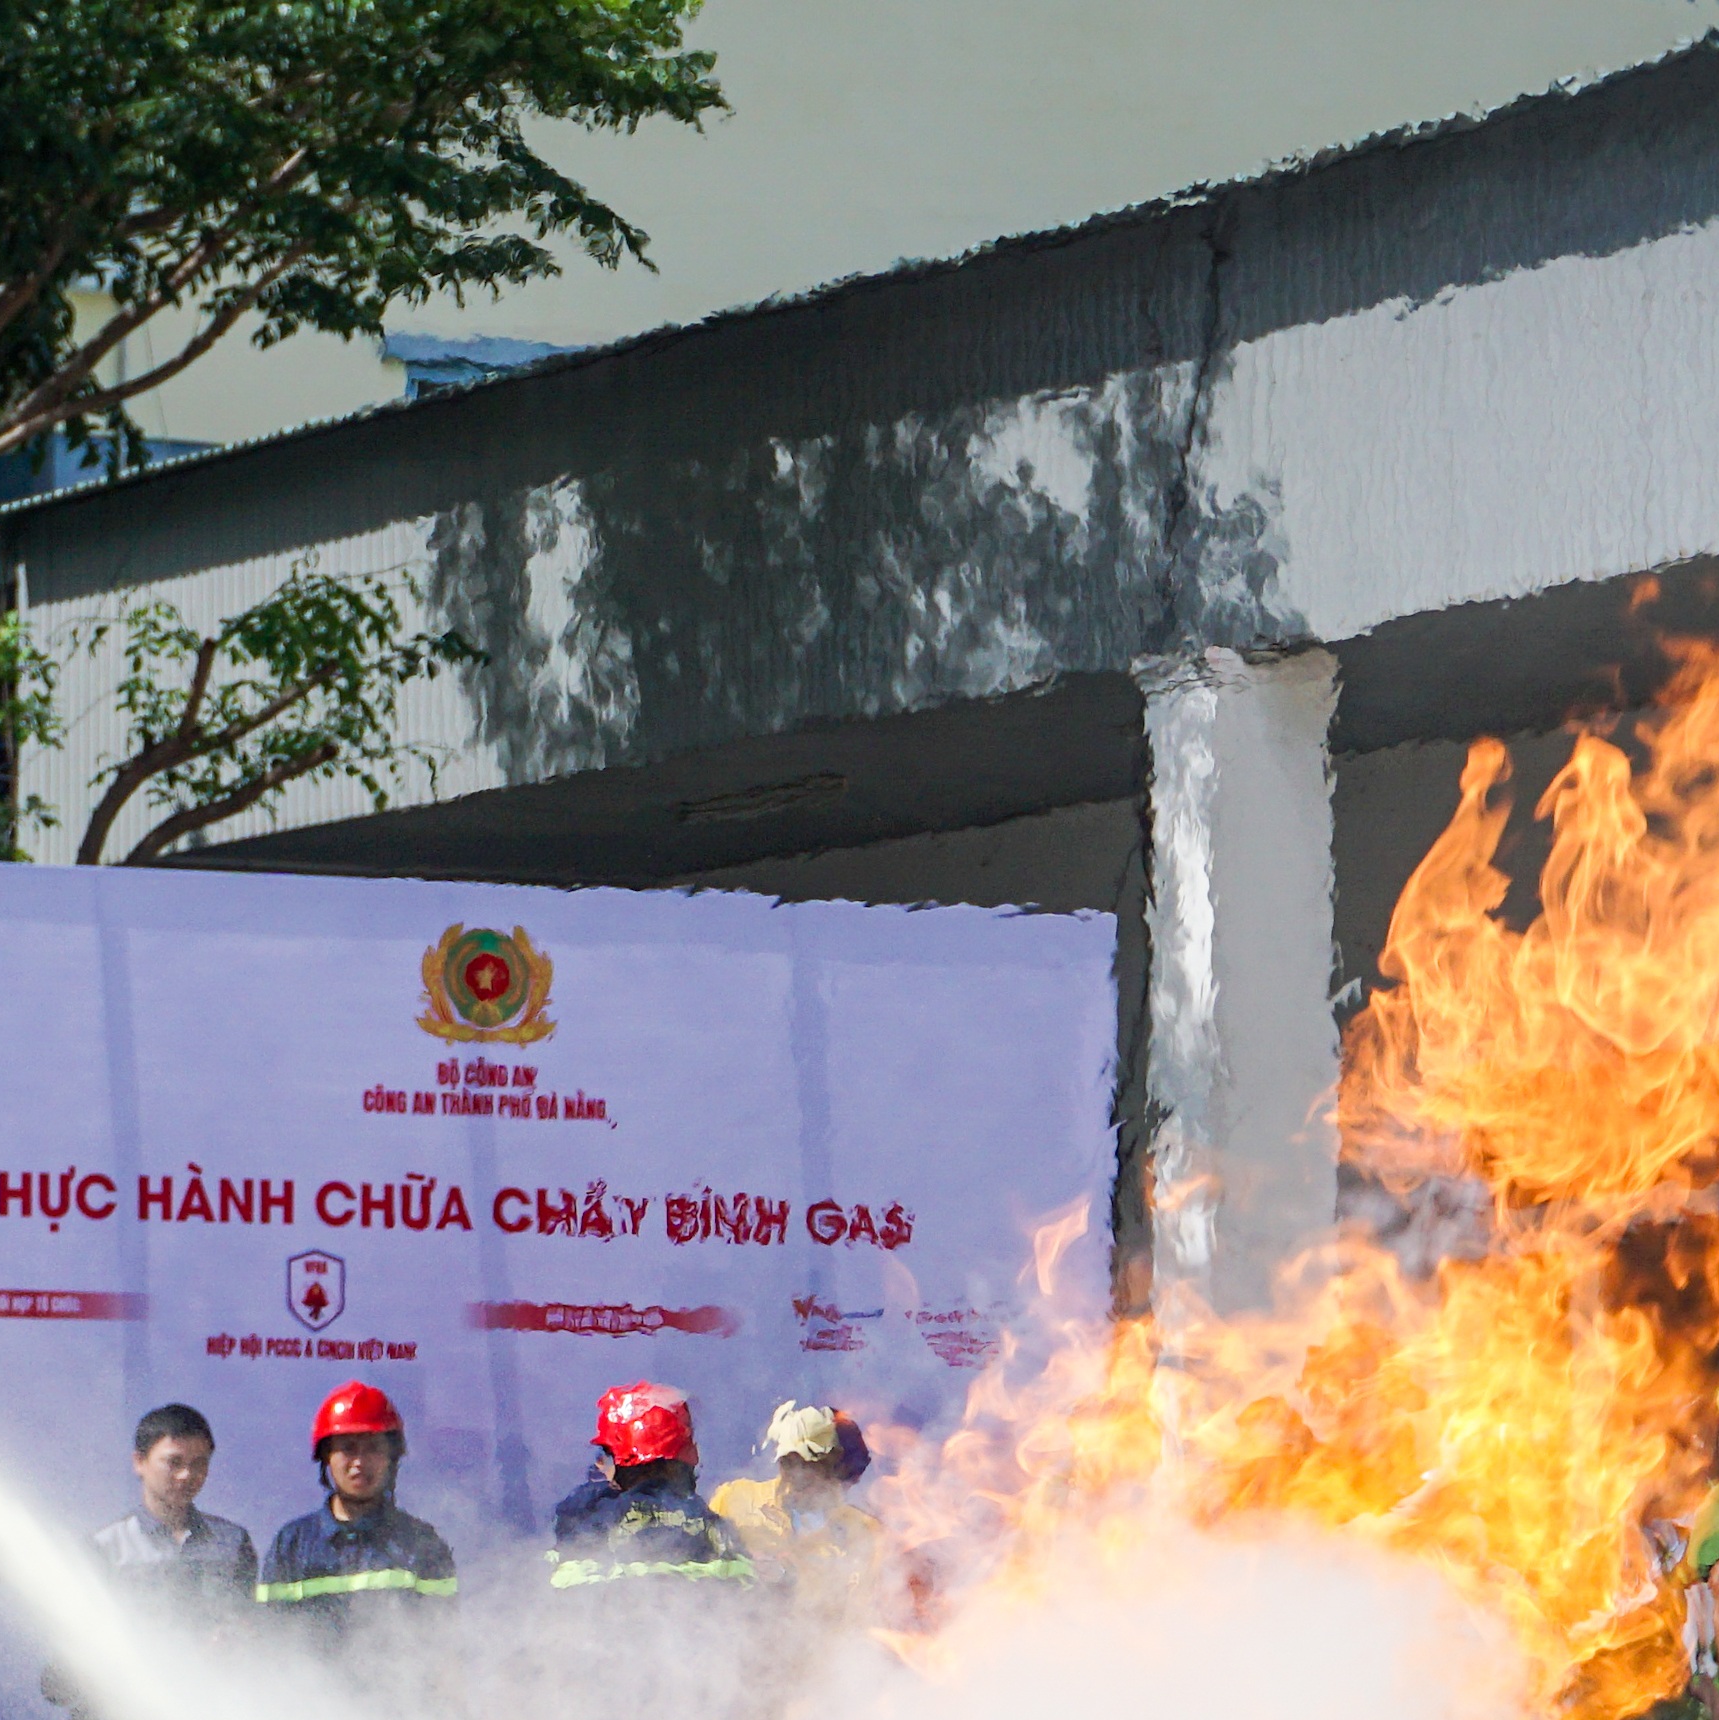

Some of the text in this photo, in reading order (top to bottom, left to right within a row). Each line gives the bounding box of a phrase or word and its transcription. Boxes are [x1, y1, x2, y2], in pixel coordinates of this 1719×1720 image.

[363, 1084, 407, 1114] CÔNG
[412, 1092, 436, 1115] AN
[441, 1087, 494, 1116] THÀNH
[137, 1162, 294, 1225] HÀNH
[315, 1172, 473, 1232] CHỮA
[806, 1199, 915, 1250] GAS
